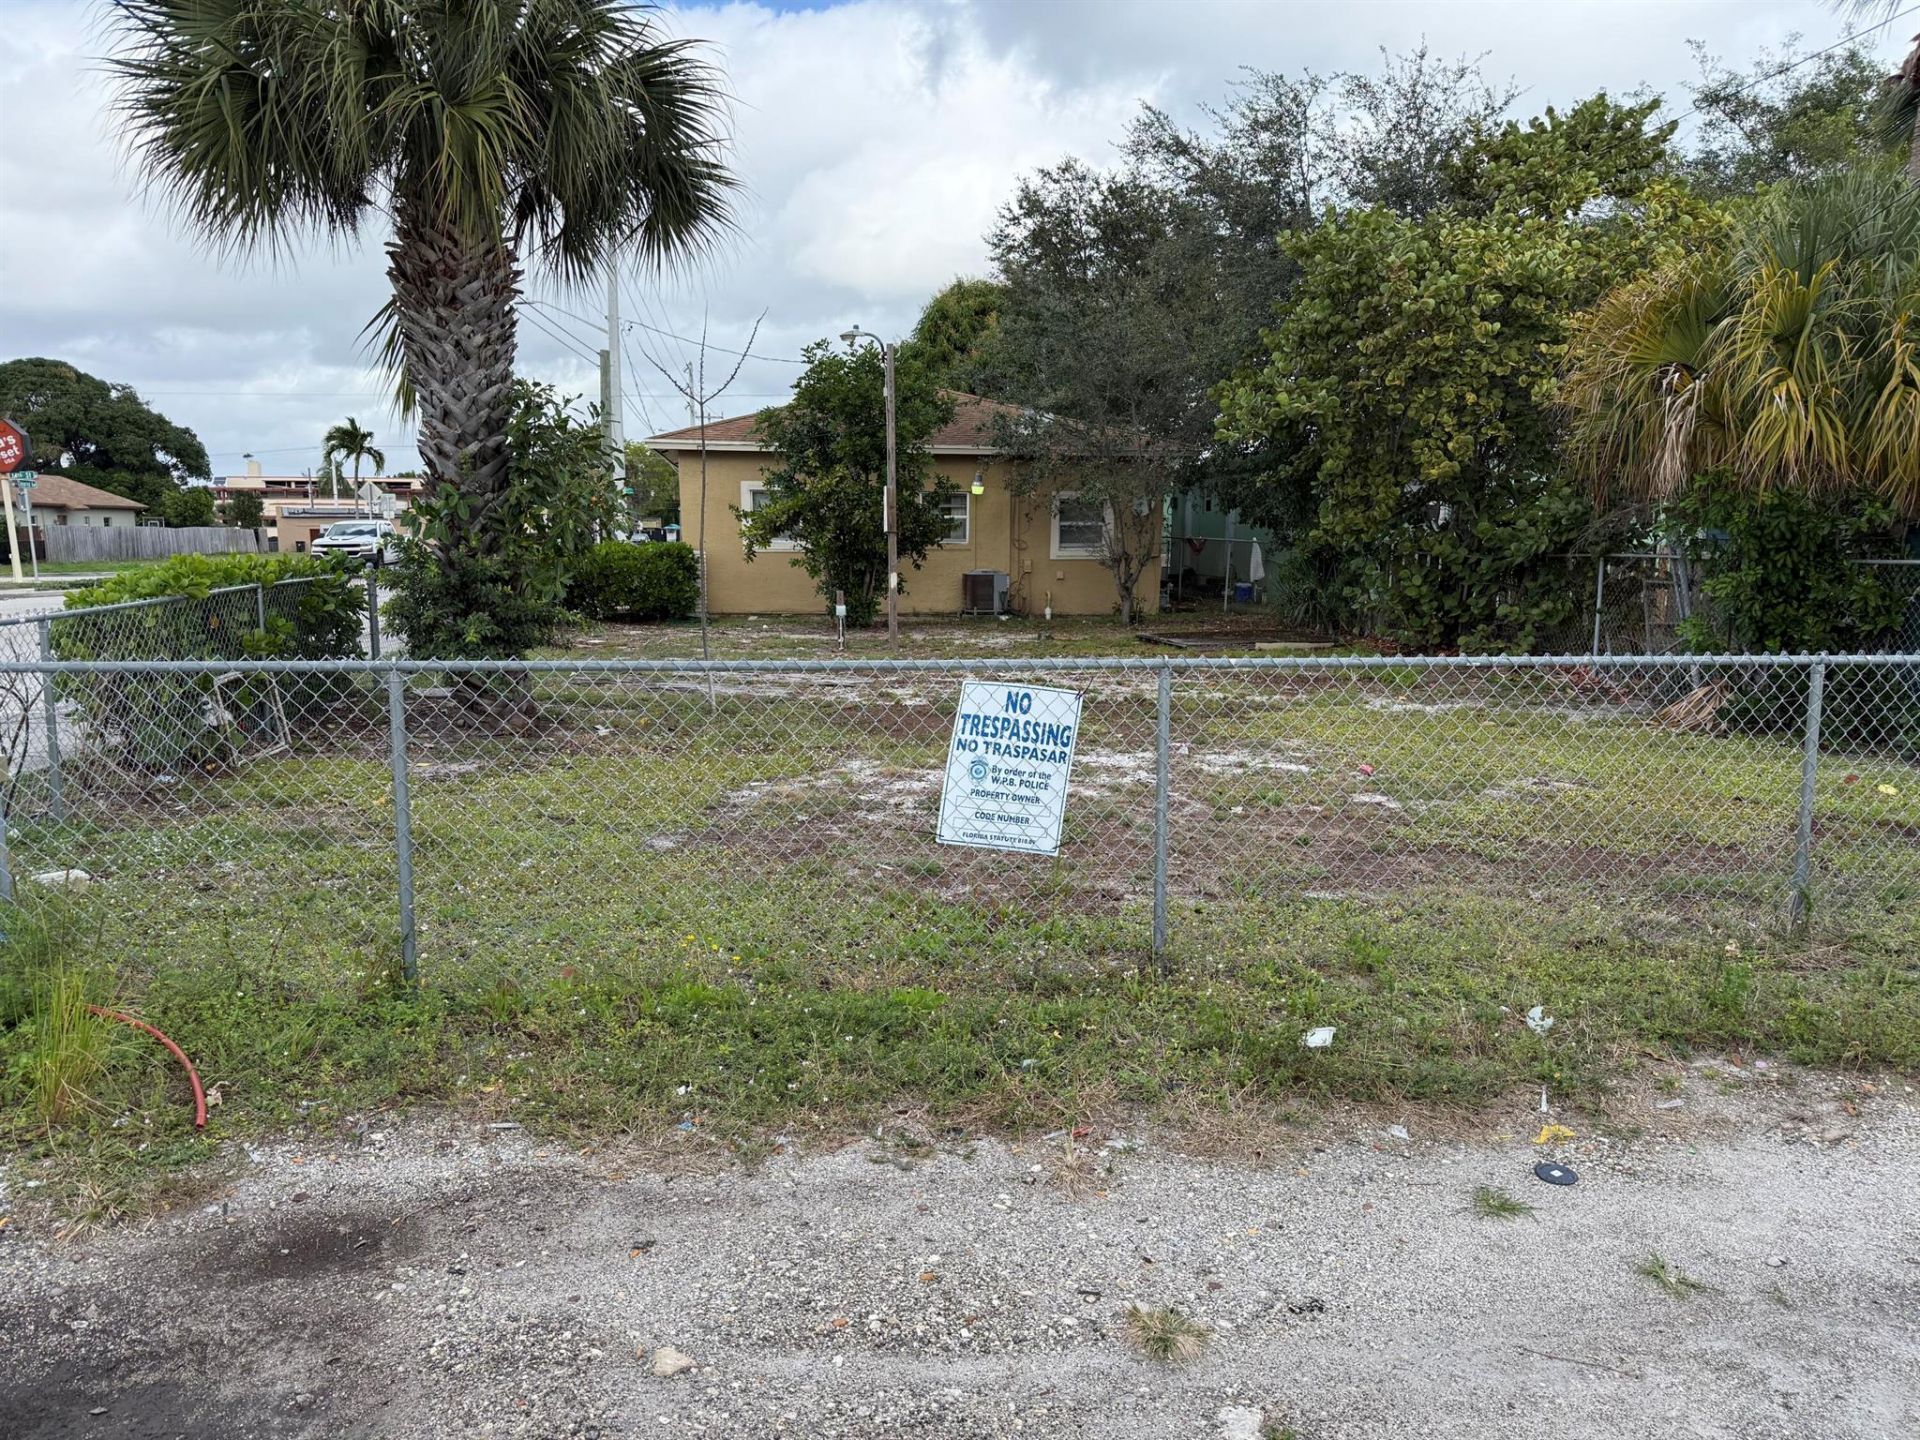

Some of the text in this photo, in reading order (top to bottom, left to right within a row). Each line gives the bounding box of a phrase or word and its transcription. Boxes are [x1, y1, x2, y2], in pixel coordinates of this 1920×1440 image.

[1005, 691, 1032, 715] NO
[960, 714, 1072, 748] TRESPASSING
[956, 738, 1068, 764] NO TRASPASAR
[991, 765, 1052, 780] By order of the
[991, 776, 1049, 791] W.P.B. POLICE
[970, 788, 1040, 804] PROPERTY OWNER
[975, 811, 1030, 825] CODE NUMBER
[962, 831, 988, 841] FLORIDA
[989, 834, 1017, 844] STATUTE
